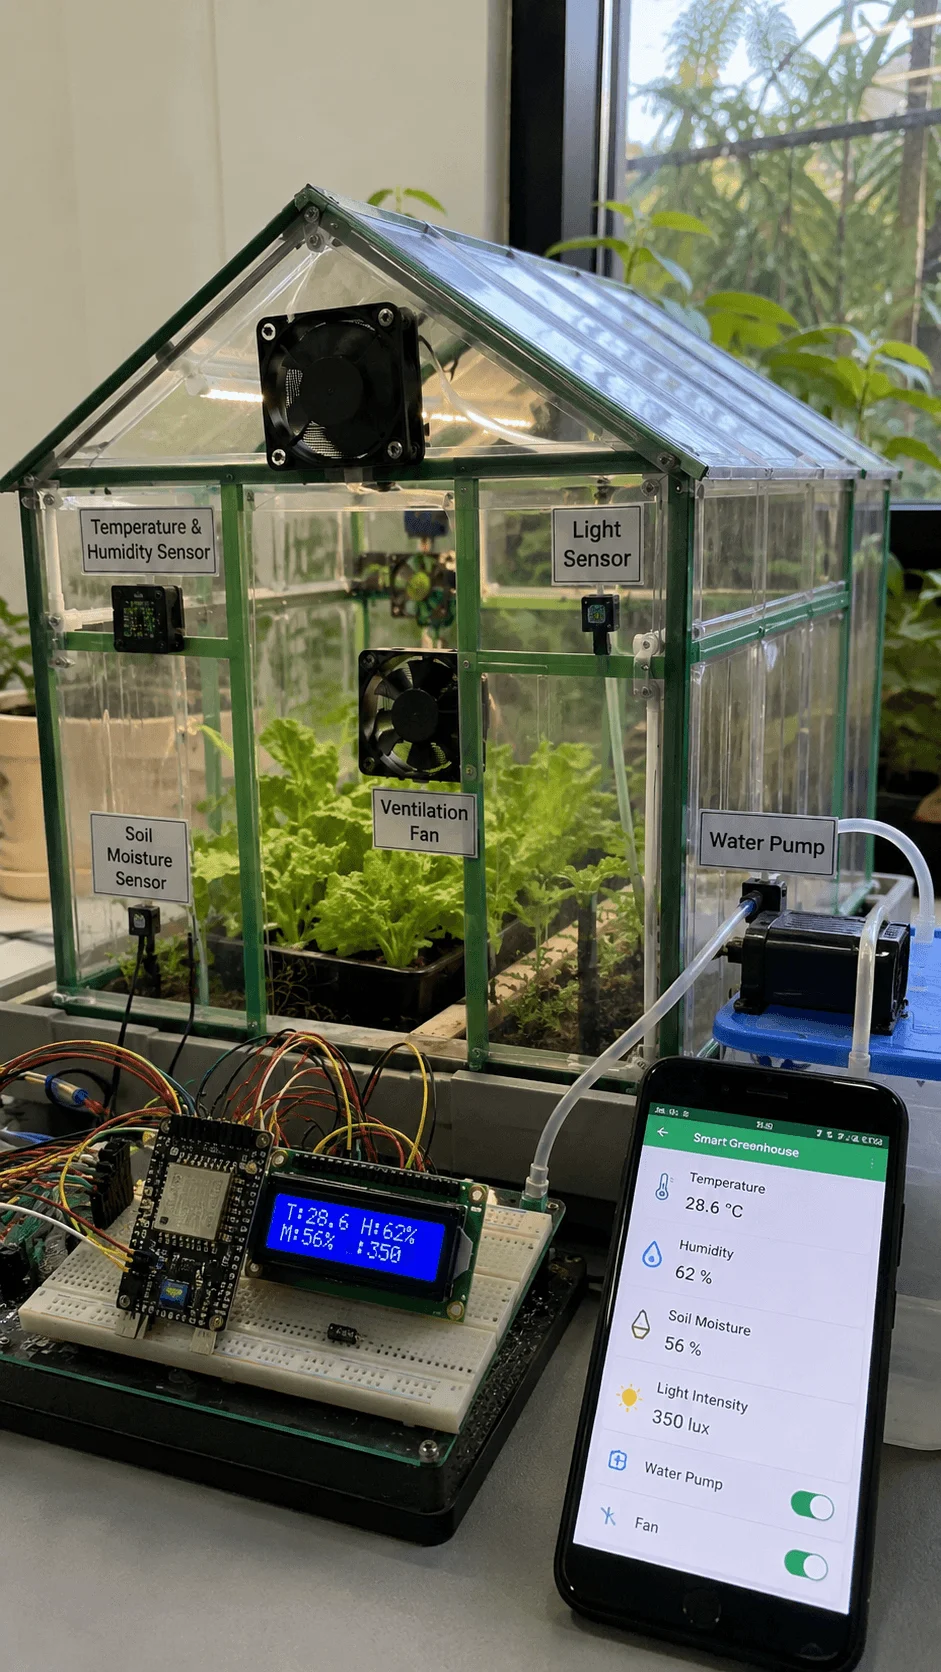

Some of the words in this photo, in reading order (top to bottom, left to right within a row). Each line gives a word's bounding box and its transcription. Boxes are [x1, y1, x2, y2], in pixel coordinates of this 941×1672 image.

[90, 518, 186, 538] Temperature
[191, 518, 202, 535] &
[573, 519, 622, 542] Light
[87, 543, 152, 564] Humidity
[157, 543, 211, 560] Sensor
[564, 549, 632, 568] Sensor
[380, 799, 468, 821] Ventilation
[125, 826, 152, 842] Soil
[410, 825, 439, 842] Fan
[709, 831, 764, 851] Water
[770, 835, 825, 859] Pump
[107, 846, 173, 868] Moisture
[116, 870, 167, 890] Sensor
[693, 1132, 727, 1147] Smart
[730, 1138, 800, 1158] Greenhouse
[689, 1172, 766, 1194] Temperature
[685, 1196, 720, 1215] 28.6
[725, 1202, 744, 1218] °C
[286, 1202, 350, 1231] T:28.6
[360, 1217, 418, 1245] H:62%
[279, 1223, 336, 1250] M:56%
[679, 1239, 734, 1262] Humidity
[674, 1265, 696, 1282] 62
[700, 1270, 712, 1285] %
[668, 1310, 692, 1326] Soil
[695, 1315, 752, 1337] Moisture
[664, 1336, 685, 1354] 56
[689, 1341, 702, 1357] %
[656, 1382, 689, 1400] Light
[692, 1390, 749, 1416] Intensity
[652, 1409, 684, 1430] 350
[688, 1417, 710, 1436] lux
[644, 1461, 682, 1481] Water
[685, 1472, 723, 1493] Pump
[634, 1516, 659, 1534] Fan
